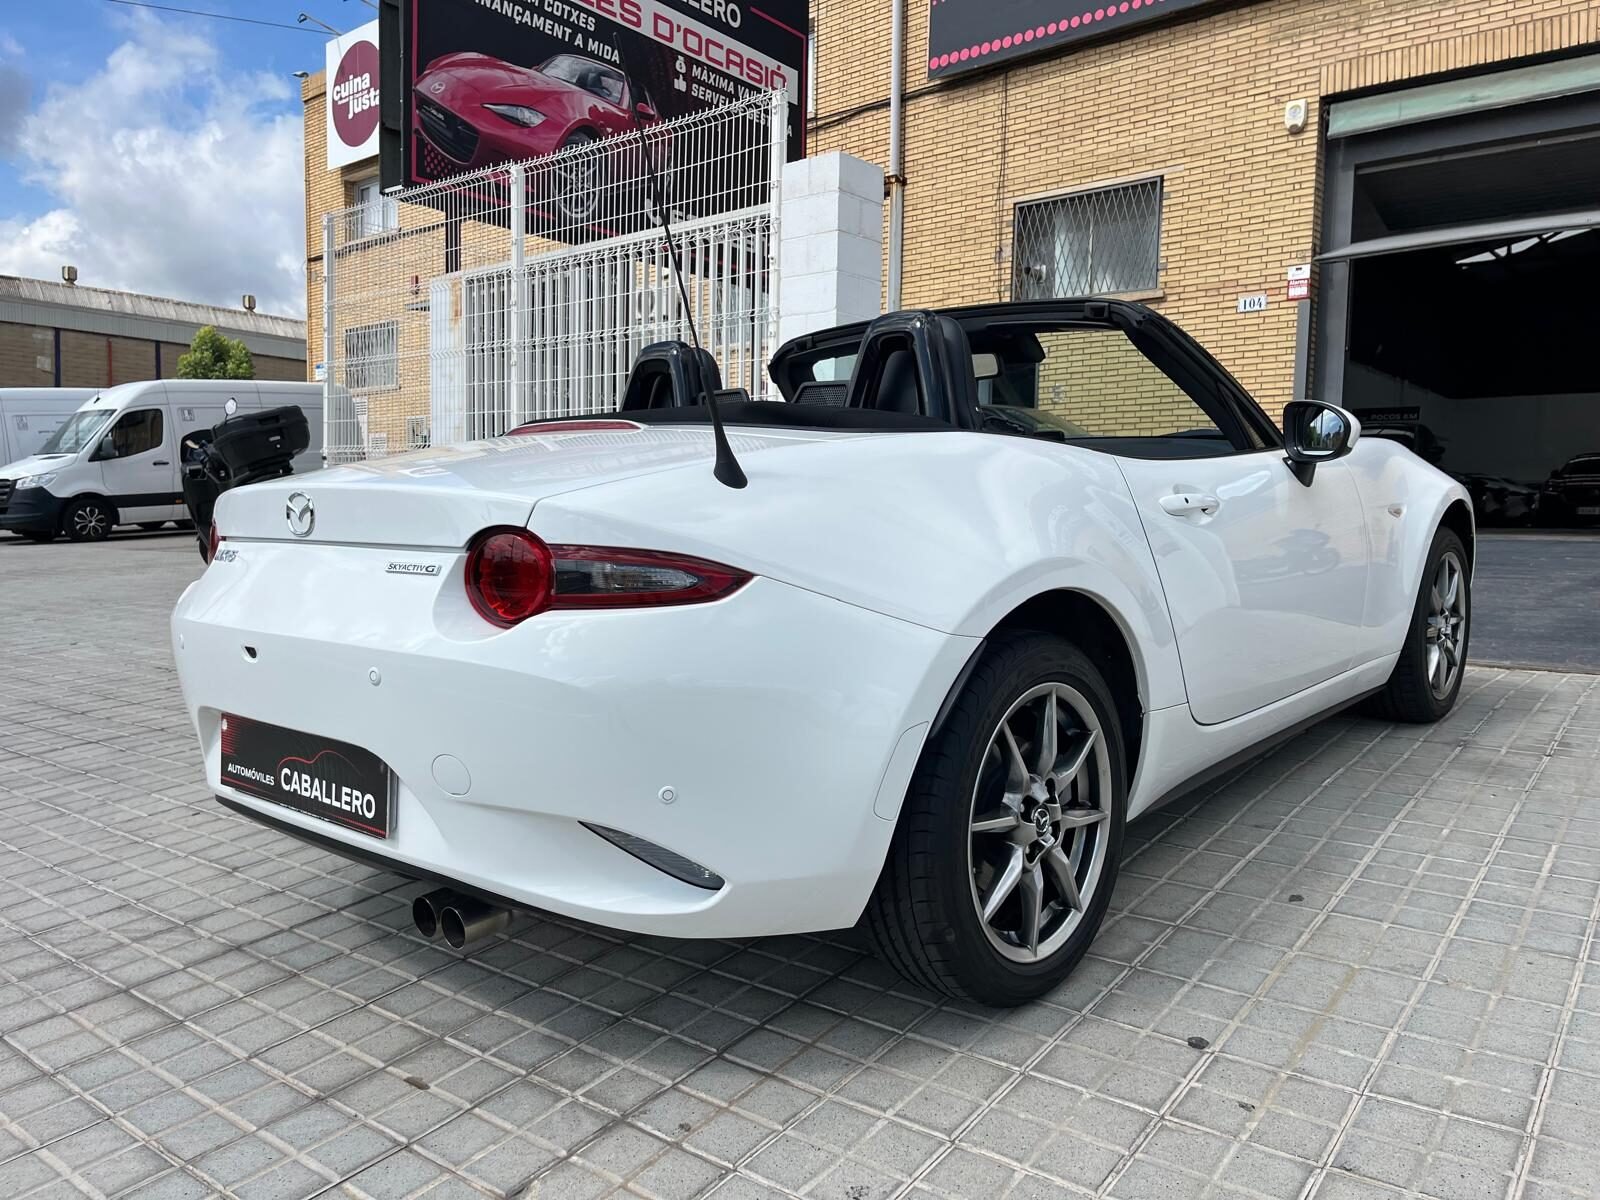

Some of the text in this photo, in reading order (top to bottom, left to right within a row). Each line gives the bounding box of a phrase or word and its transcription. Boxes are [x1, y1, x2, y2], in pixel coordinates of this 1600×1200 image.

[543, 0, 597, 32] COTXES
[682, 0, 742, 28] ERO
[475, 0, 620, 64] ANÇAMENT A MIDA
[580, 0, 788, 91] ES D'OCASIÓ
[333, 72, 371, 101] cuina
[691, 64, 735, 95] MÀXIMA
[1242, 297, 1263, 311] 104
[227, 762, 376, 819] AUTOMÓVILES CABALLERO
